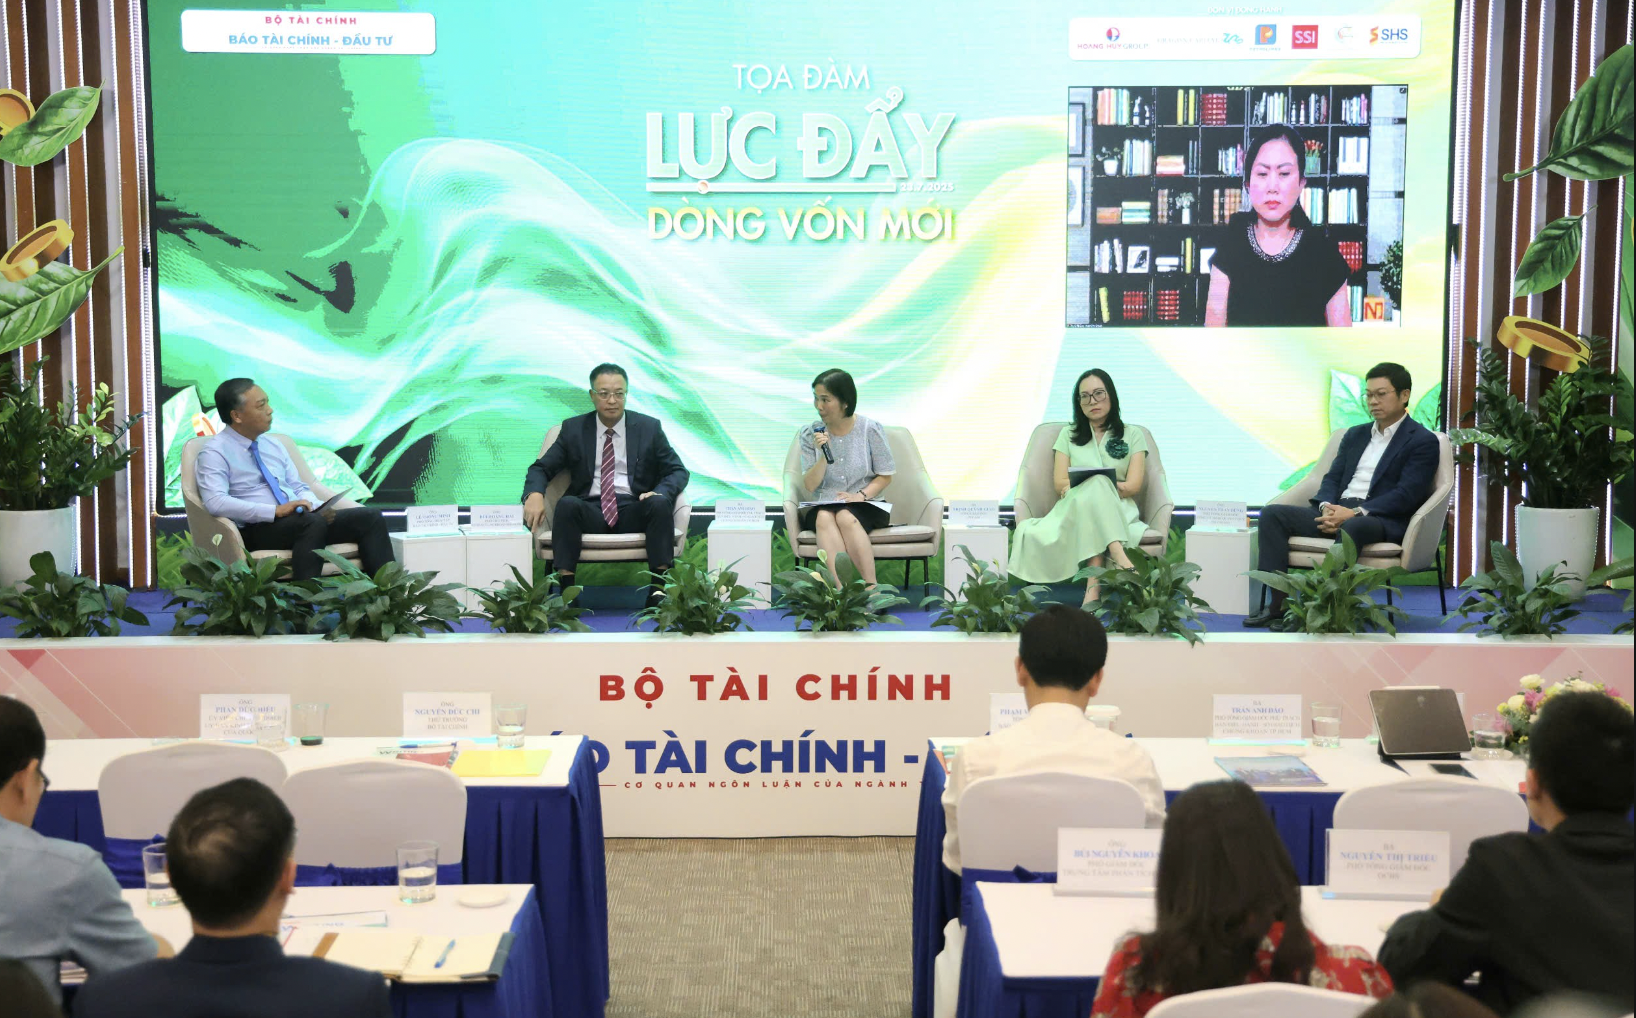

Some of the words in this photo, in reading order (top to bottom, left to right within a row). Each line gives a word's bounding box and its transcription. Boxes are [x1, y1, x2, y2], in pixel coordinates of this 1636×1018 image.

[264, 14, 283, 26] BỘ
[289, 15, 310, 25] TÀI
[316, 15, 357, 25] CHÍNH
[229, 32, 258, 45] BÁO
[262, 32, 283, 45] TÀI
[287, 33, 330, 46] CHÍNH
[342, 32, 372, 46] ĐẦU
[375, 34, 393, 46] TƯ
[1294, 30, 1315, 44] SSI
[1380, 28, 1409, 41] SHS
[732, 64, 793, 94] TỌA
[802, 57, 870, 89] ĐÀM
[646, 106, 777, 195] LỰC
[796, 86, 957, 180] ĐẨY
[648, 196, 766, 241] DÒNG
[778, 195, 866, 241] VỐN
[879, 197, 953, 241] MỚI
[599, 666, 664, 709] BỘ
[690, 666, 768, 701] TÀI
[796, 666, 951, 702] CHÍNH
[625, 730, 706, 774] TÀI
[725, 730, 886, 774] CHÍNH
[624, 780, 643, 789] CƠ
[654, 781, 697, 791] QUAN
[708, 779, 751, 789] NGÔN
[761, 778, 802, 791] LUẬN
[813, 778, 844, 789] CỦA
[854, 779, 908, 789] NGÀNH
